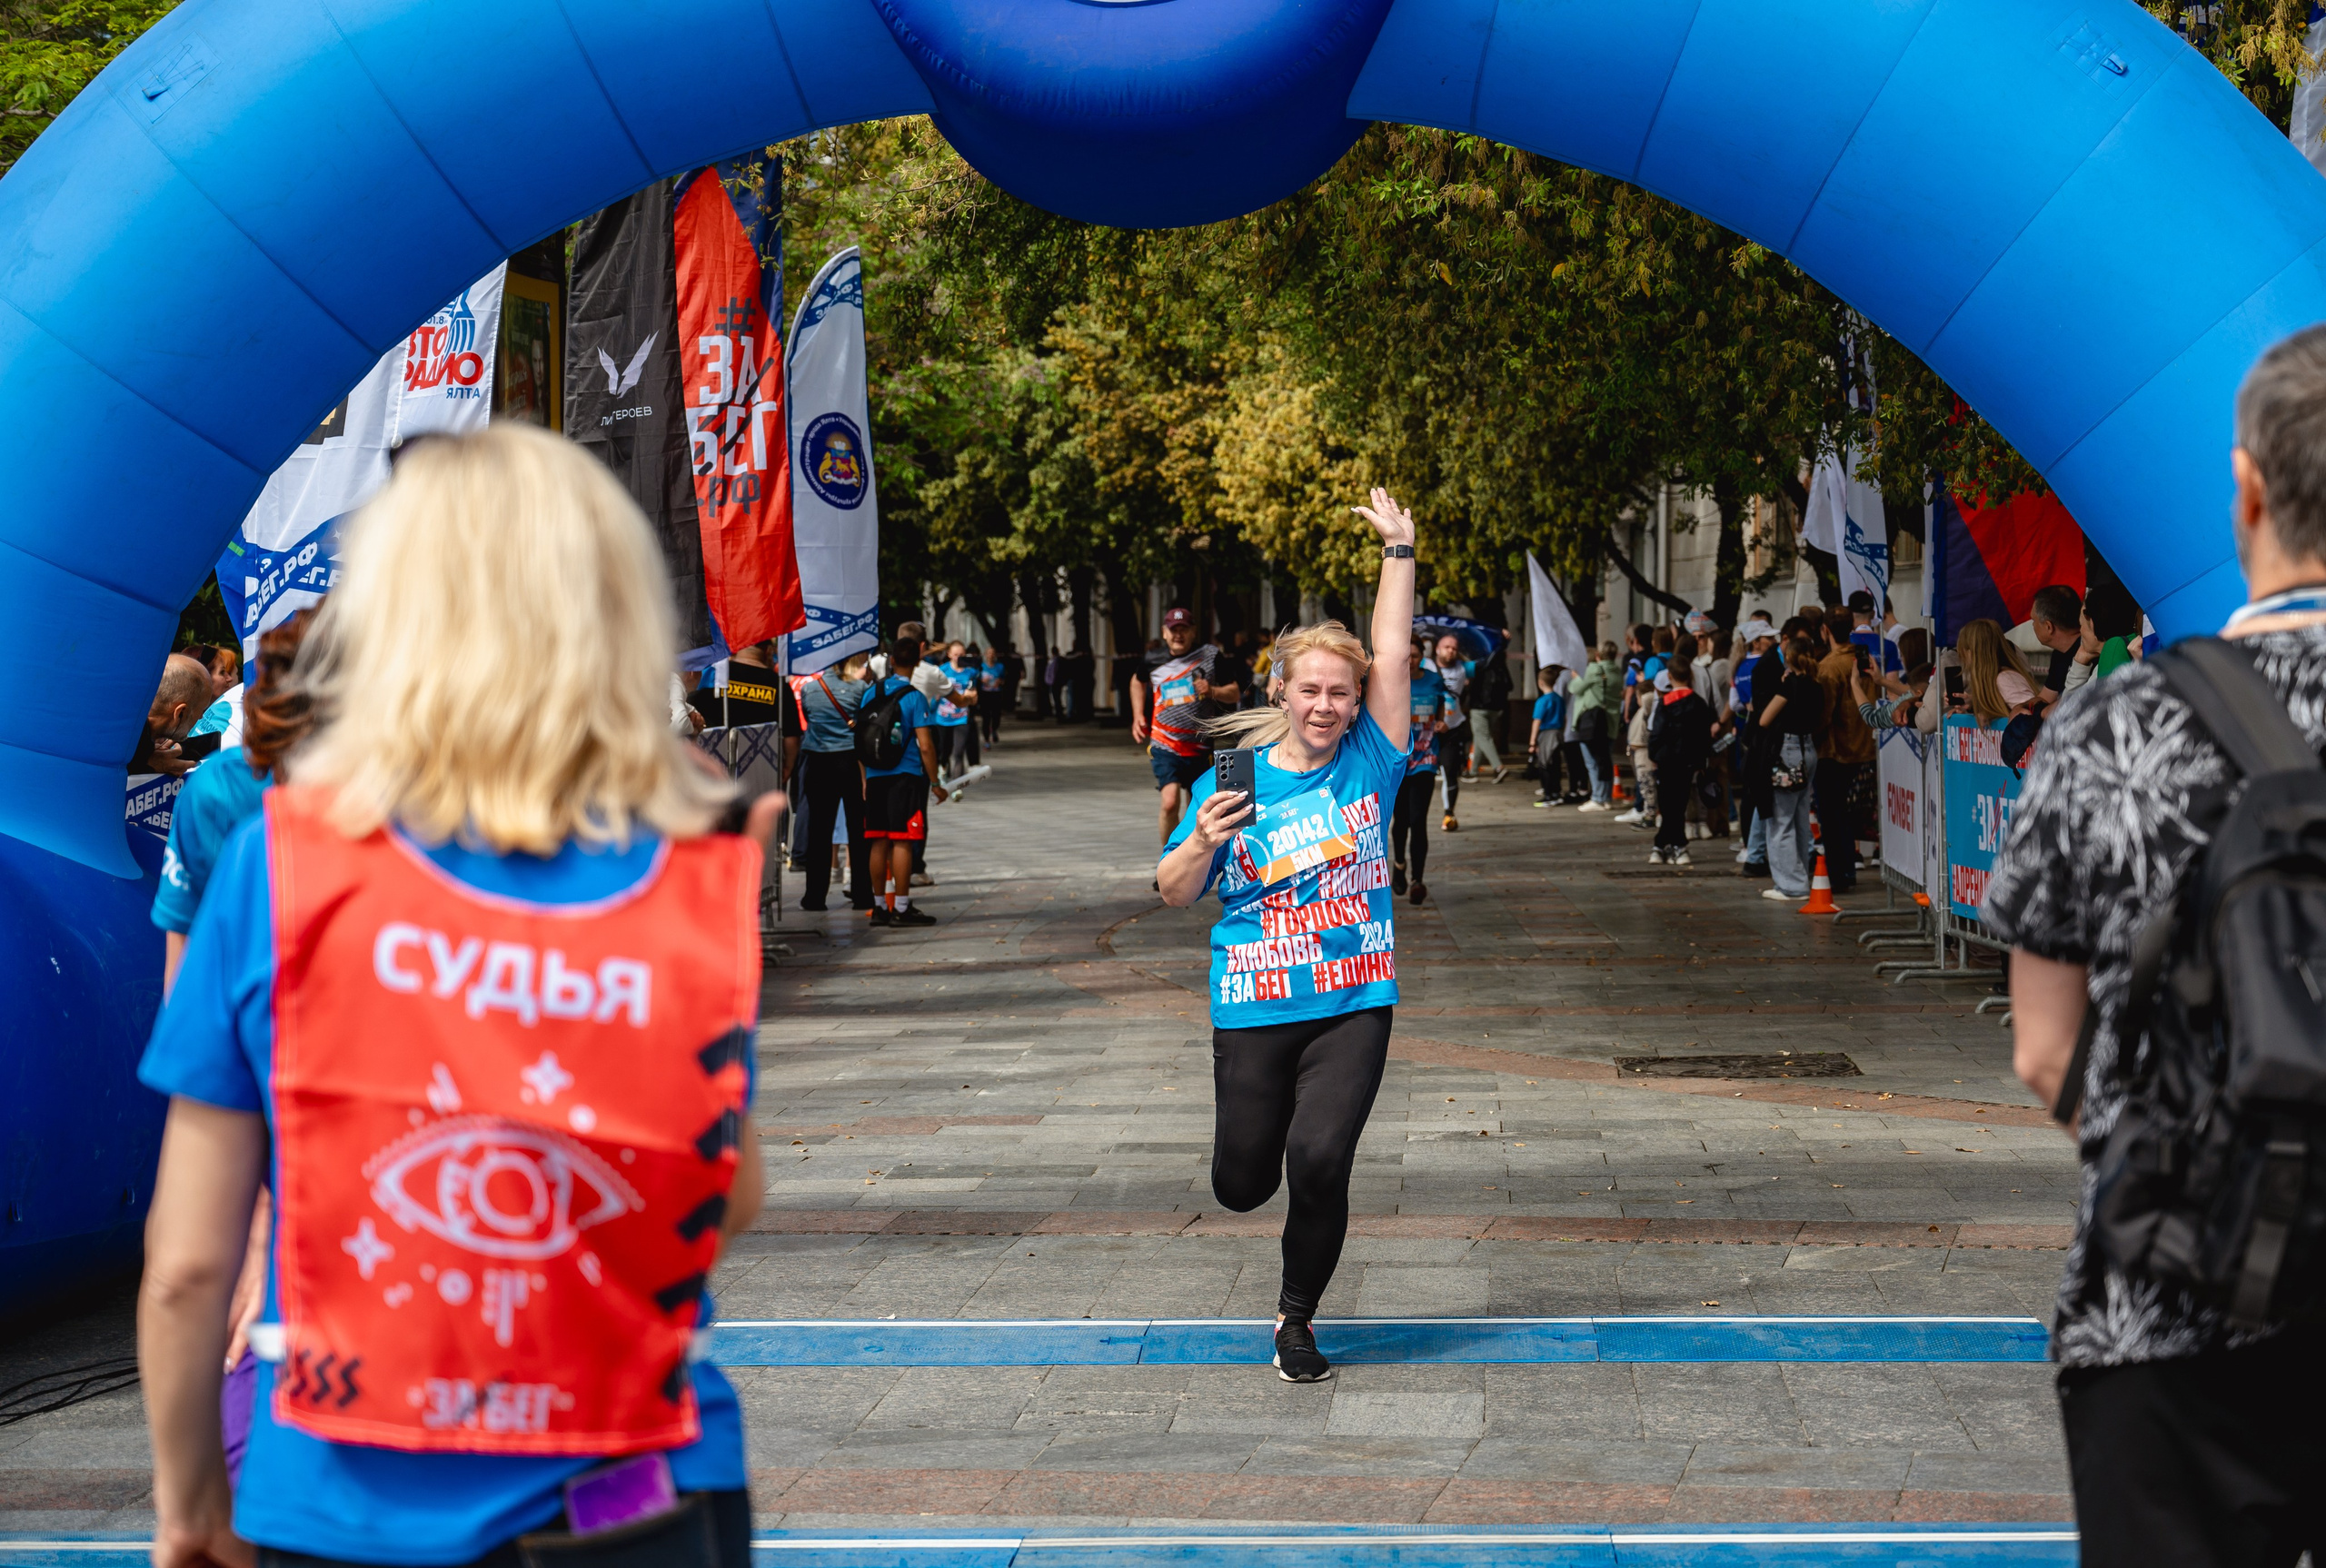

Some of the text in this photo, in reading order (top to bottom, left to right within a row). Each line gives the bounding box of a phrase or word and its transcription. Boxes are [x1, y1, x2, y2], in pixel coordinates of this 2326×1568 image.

[699, 335, 762, 405] ЗА
[446, 387, 480, 399] ЯЛТА
[686, 401, 777, 477] БЕГ
[811, 613, 874, 648] ЗАБЕГ.РФ
[1973, 728, 2008, 768] #СВОБО
[125, 778, 184, 819] АБЕГ.РФ
[1256, 812, 1267, 821] СБ
[1887, 782, 1914, 834] FONBET
[1267, 814, 1329, 857] 20142
[1358, 823, 1384, 861] 202
[1290, 843, 1327, 871] 5КМ
[1317, 856, 1391, 899] #МОМЕН
[1261, 893, 1371, 938] #ГОРДОСТЬ
[1359, 919, 1394, 953] 2024
[1227, 934, 1323, 973] #ЛЮБОВЬ
[373, 921, 652, 1028] СУДЬЯ
[1220, 951, 1395, 1004] #ЗАБЕГ #ЕДИНС
